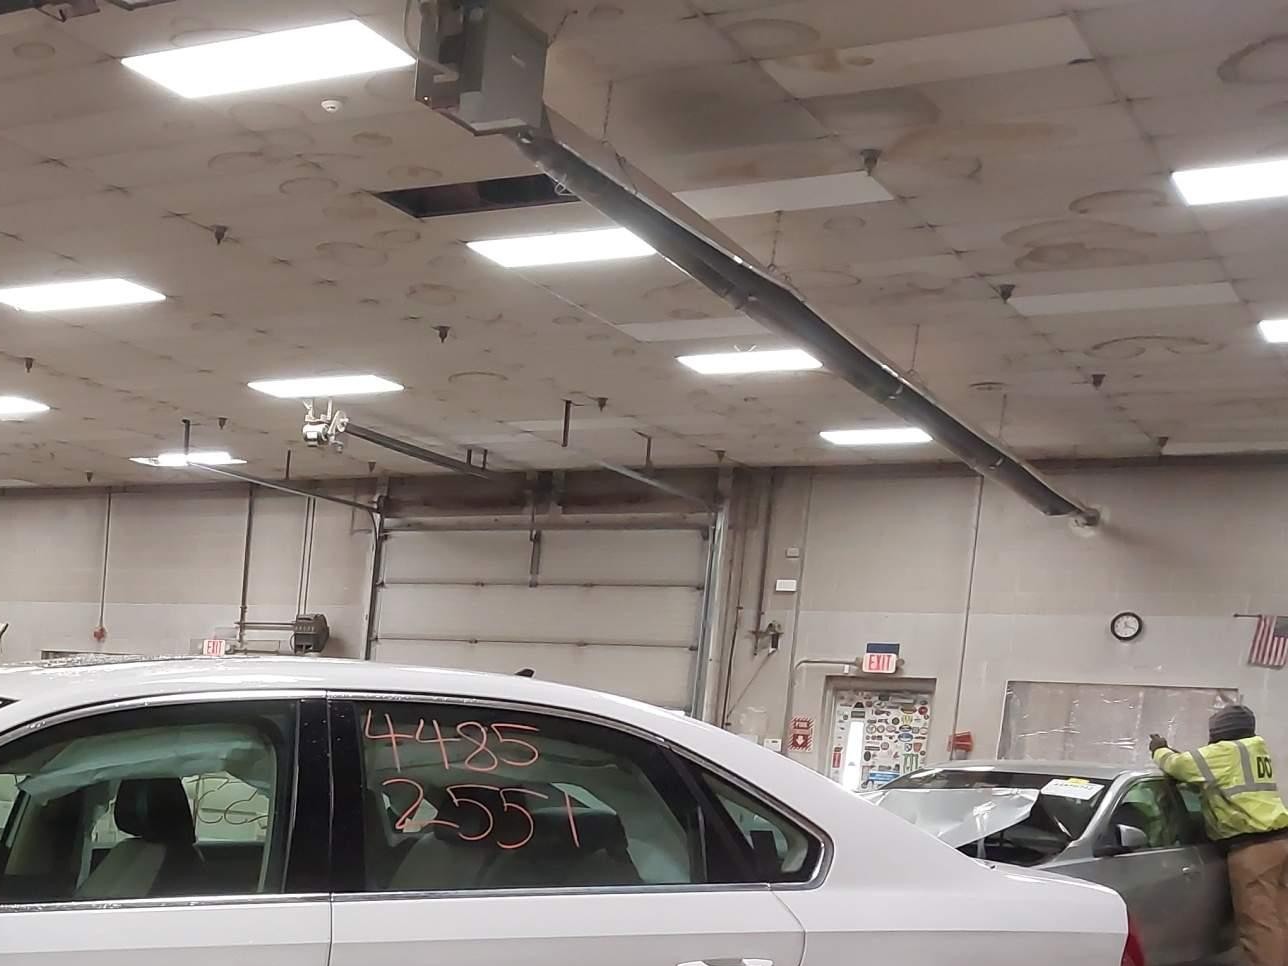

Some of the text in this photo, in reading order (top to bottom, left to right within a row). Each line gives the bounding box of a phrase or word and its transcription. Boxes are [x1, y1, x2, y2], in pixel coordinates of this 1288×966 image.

[869, 654, 892, 671] EXIT
[363, 708, 540, 773] 4485
[382, 778, 580, 849] 2551
